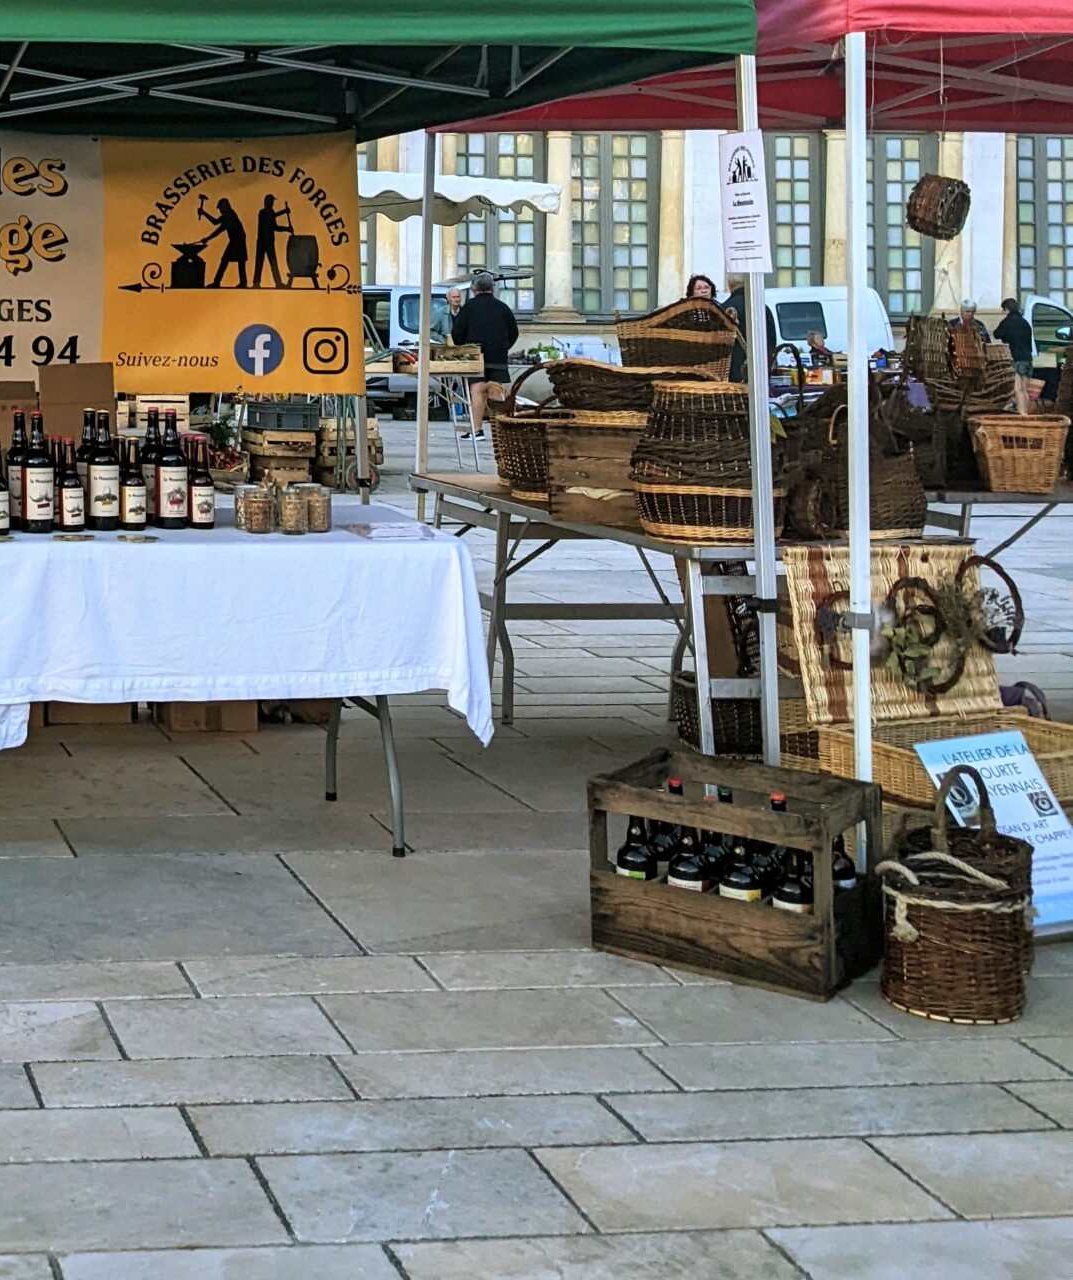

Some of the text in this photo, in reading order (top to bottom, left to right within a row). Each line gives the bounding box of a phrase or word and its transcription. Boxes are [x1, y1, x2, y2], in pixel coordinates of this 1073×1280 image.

[141, 155, 349, 246] BRASSERIE DES FORGES
[31, 334, 81, 367] 94
[115, 351, 219, 368] Suivez-nous
[942, 743, 1031, 765] L'ATELIER DE LA
[979, 762, 1023, 779] OURTE
